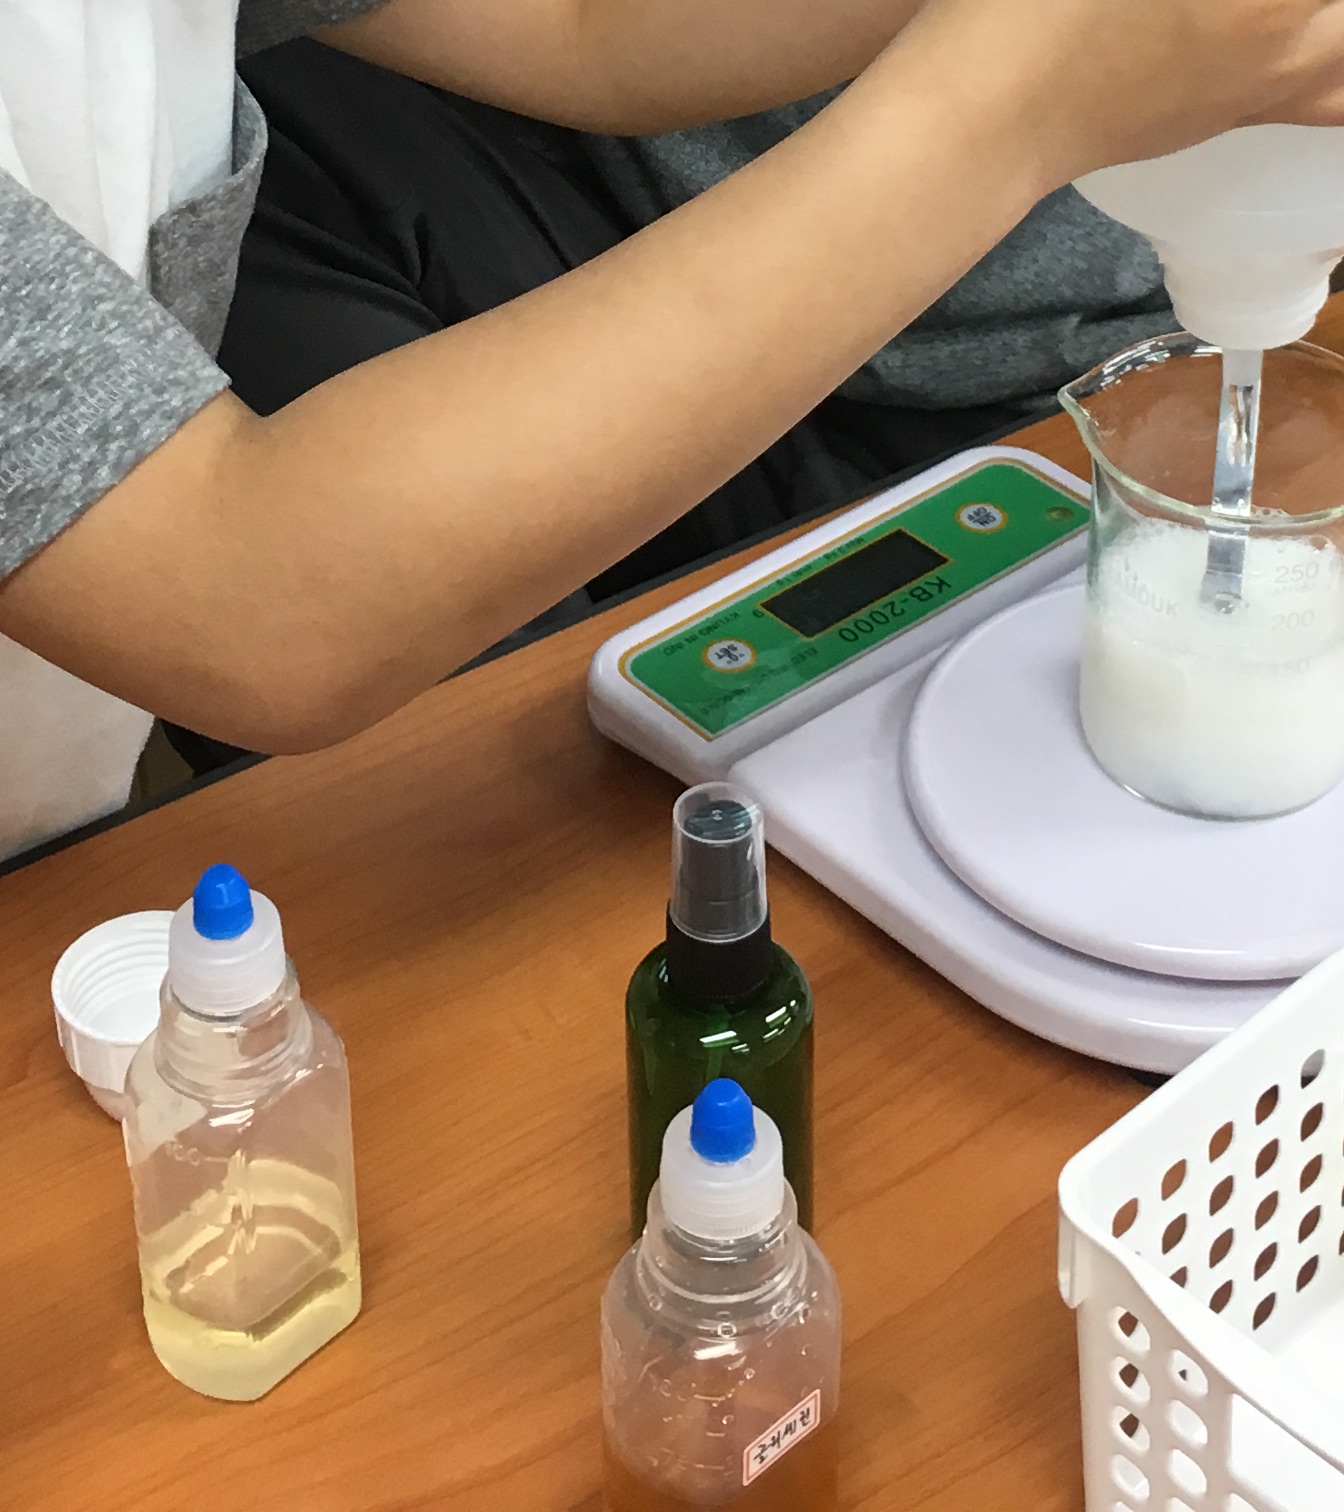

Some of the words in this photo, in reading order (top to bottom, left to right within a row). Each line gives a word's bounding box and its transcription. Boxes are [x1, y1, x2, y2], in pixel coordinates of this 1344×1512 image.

[967, 506, 988, 523] OFF
[977, 513, 997, 527] ON
[1274, 561, 1319, 584] 250
[838, 576, 952, 642] KB-2000
[1271, 609, 1314, 631] 200
